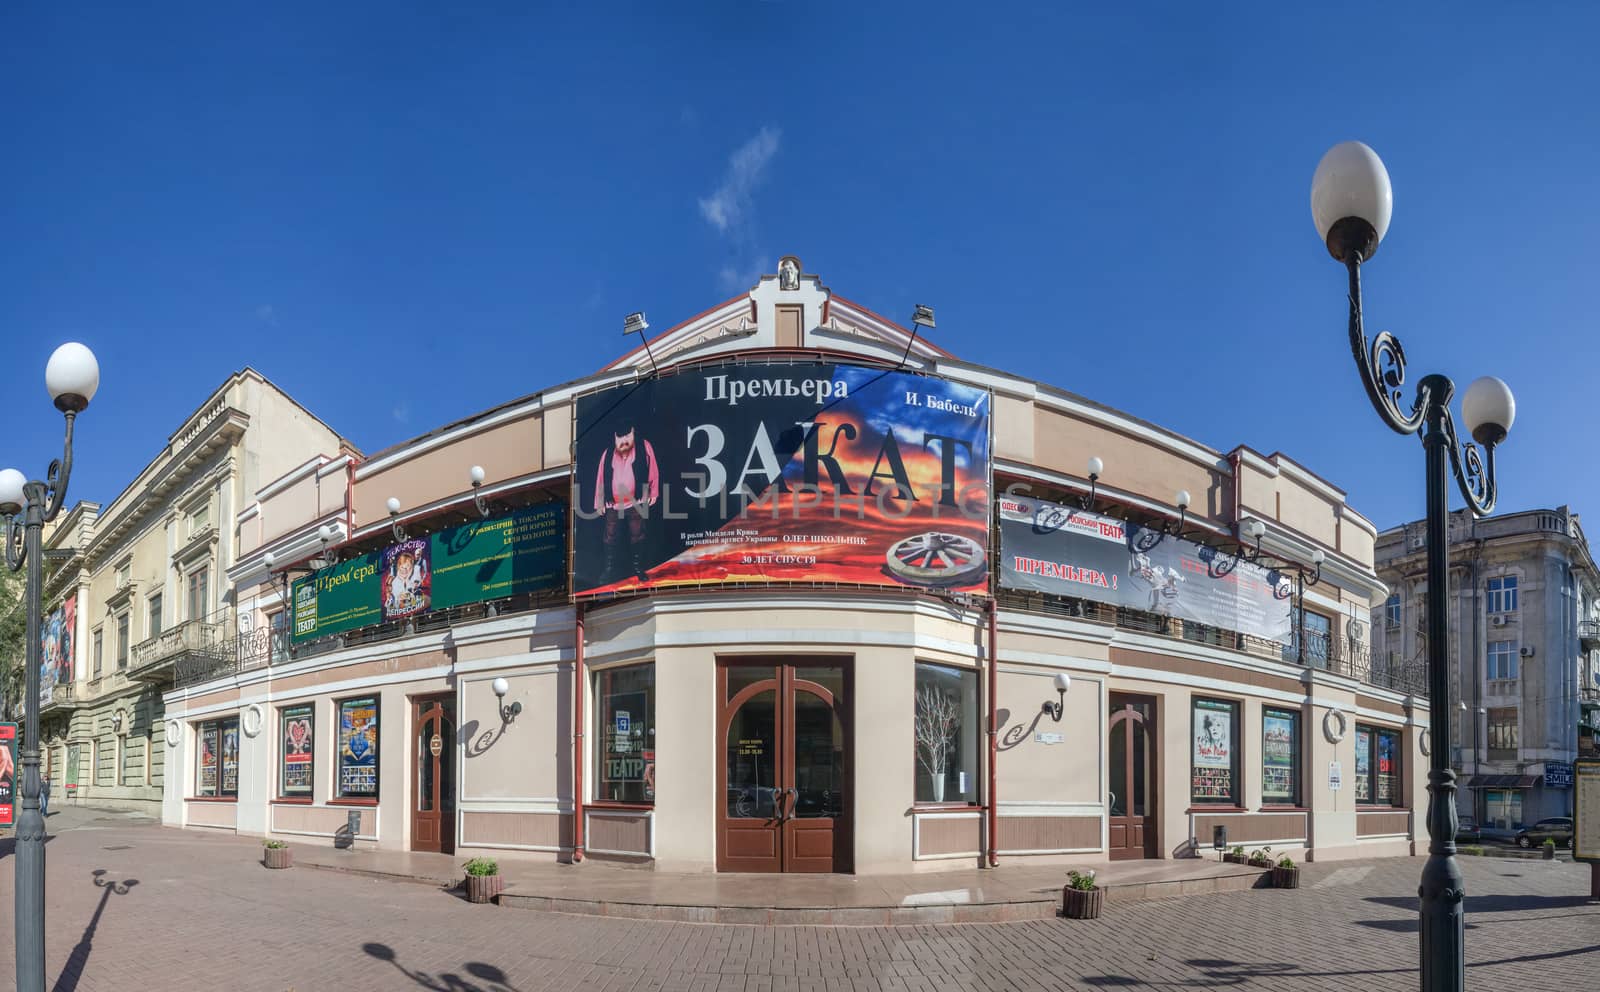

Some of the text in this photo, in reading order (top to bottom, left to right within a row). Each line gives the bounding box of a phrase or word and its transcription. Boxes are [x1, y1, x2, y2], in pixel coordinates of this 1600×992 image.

[703, 374, 849, 405] Премьера
[905, 391, 977, 418] И. Бабель
[684, 420, 972, 506] ЗАКАТ
[782, 534, 867, 545] ОЛЕГ ШКОЛЬНИК
[1098, 521, 1124, 539] ТЕАТР
[742, 555, 816, 564] 30 ЛЕТ СПУСТЯ
[1014, 556, 1109, 588] ПРЕМЬЕРА
[297, 617, 316, 633] ТЕАТР
[607, 759, 643, 778] ТЕАТР
